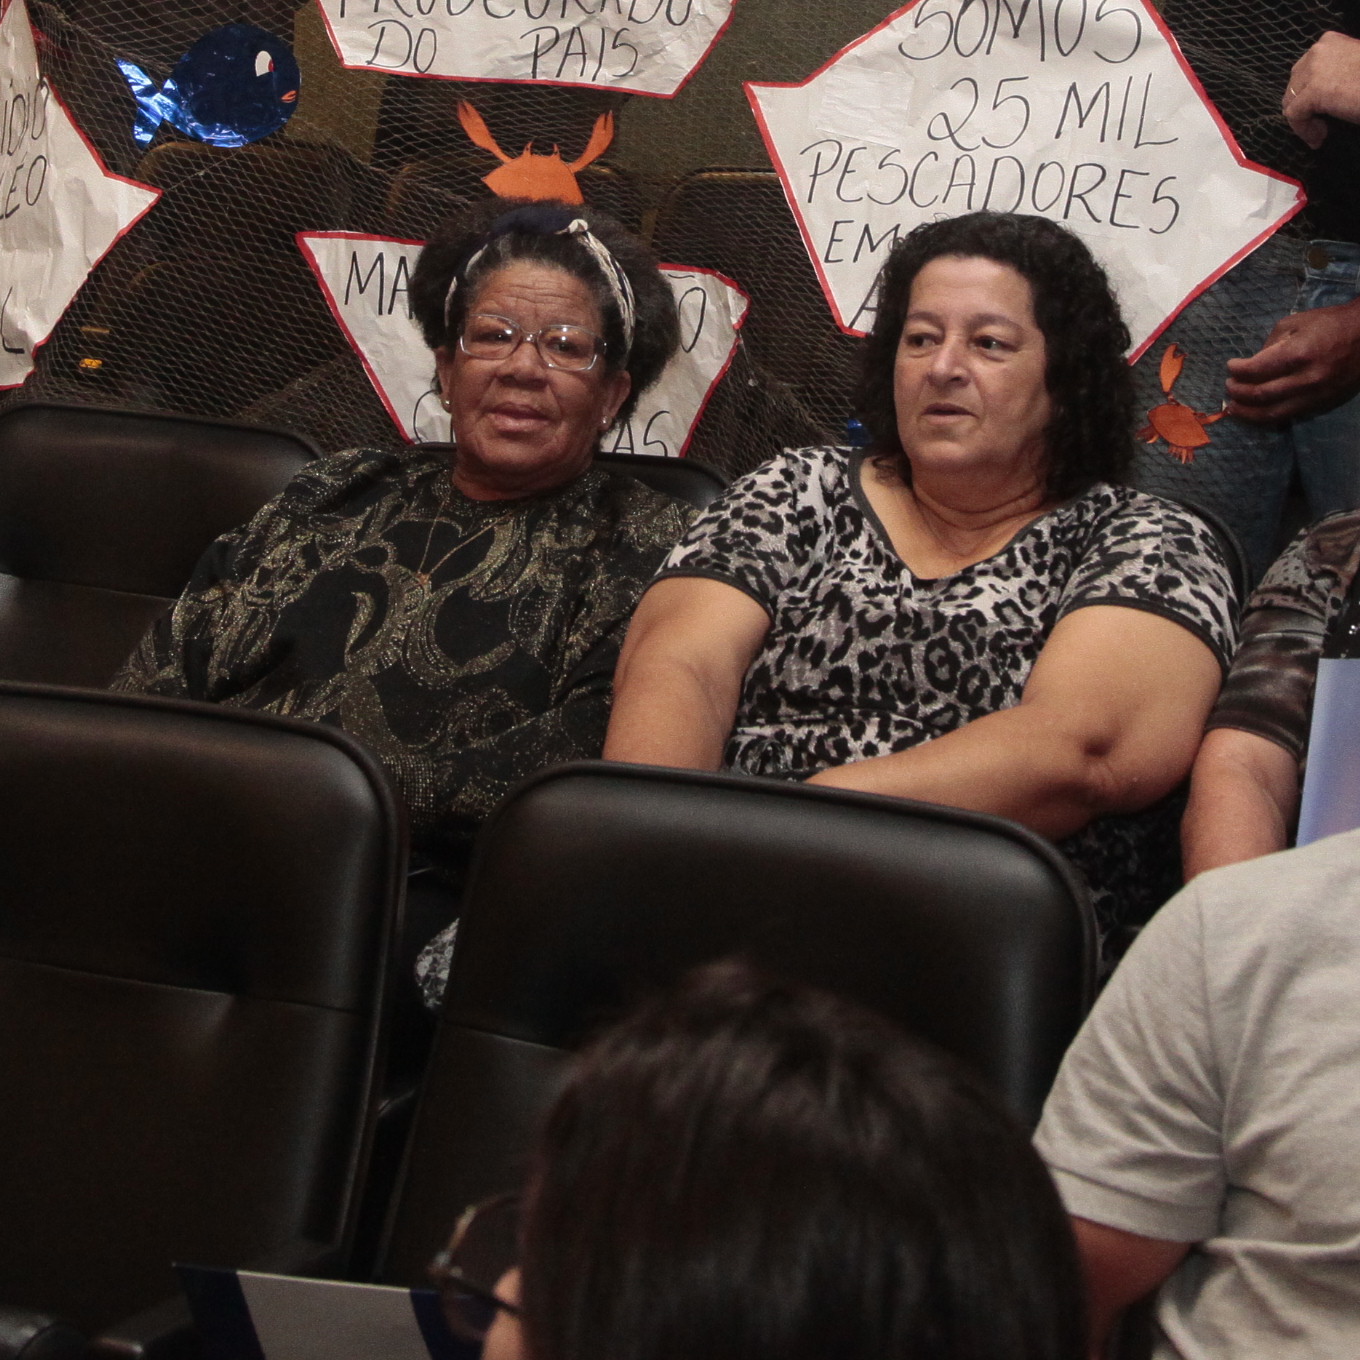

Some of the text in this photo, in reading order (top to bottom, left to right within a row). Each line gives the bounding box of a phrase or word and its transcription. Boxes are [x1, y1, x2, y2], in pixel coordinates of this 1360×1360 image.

[365, 19, 639, 81] DO PAIS
[927, 72, 1180, 152] 25 MIL
[799, 139, 1181, 235] PESCADORES
[824, 220, 901, 263] EM
